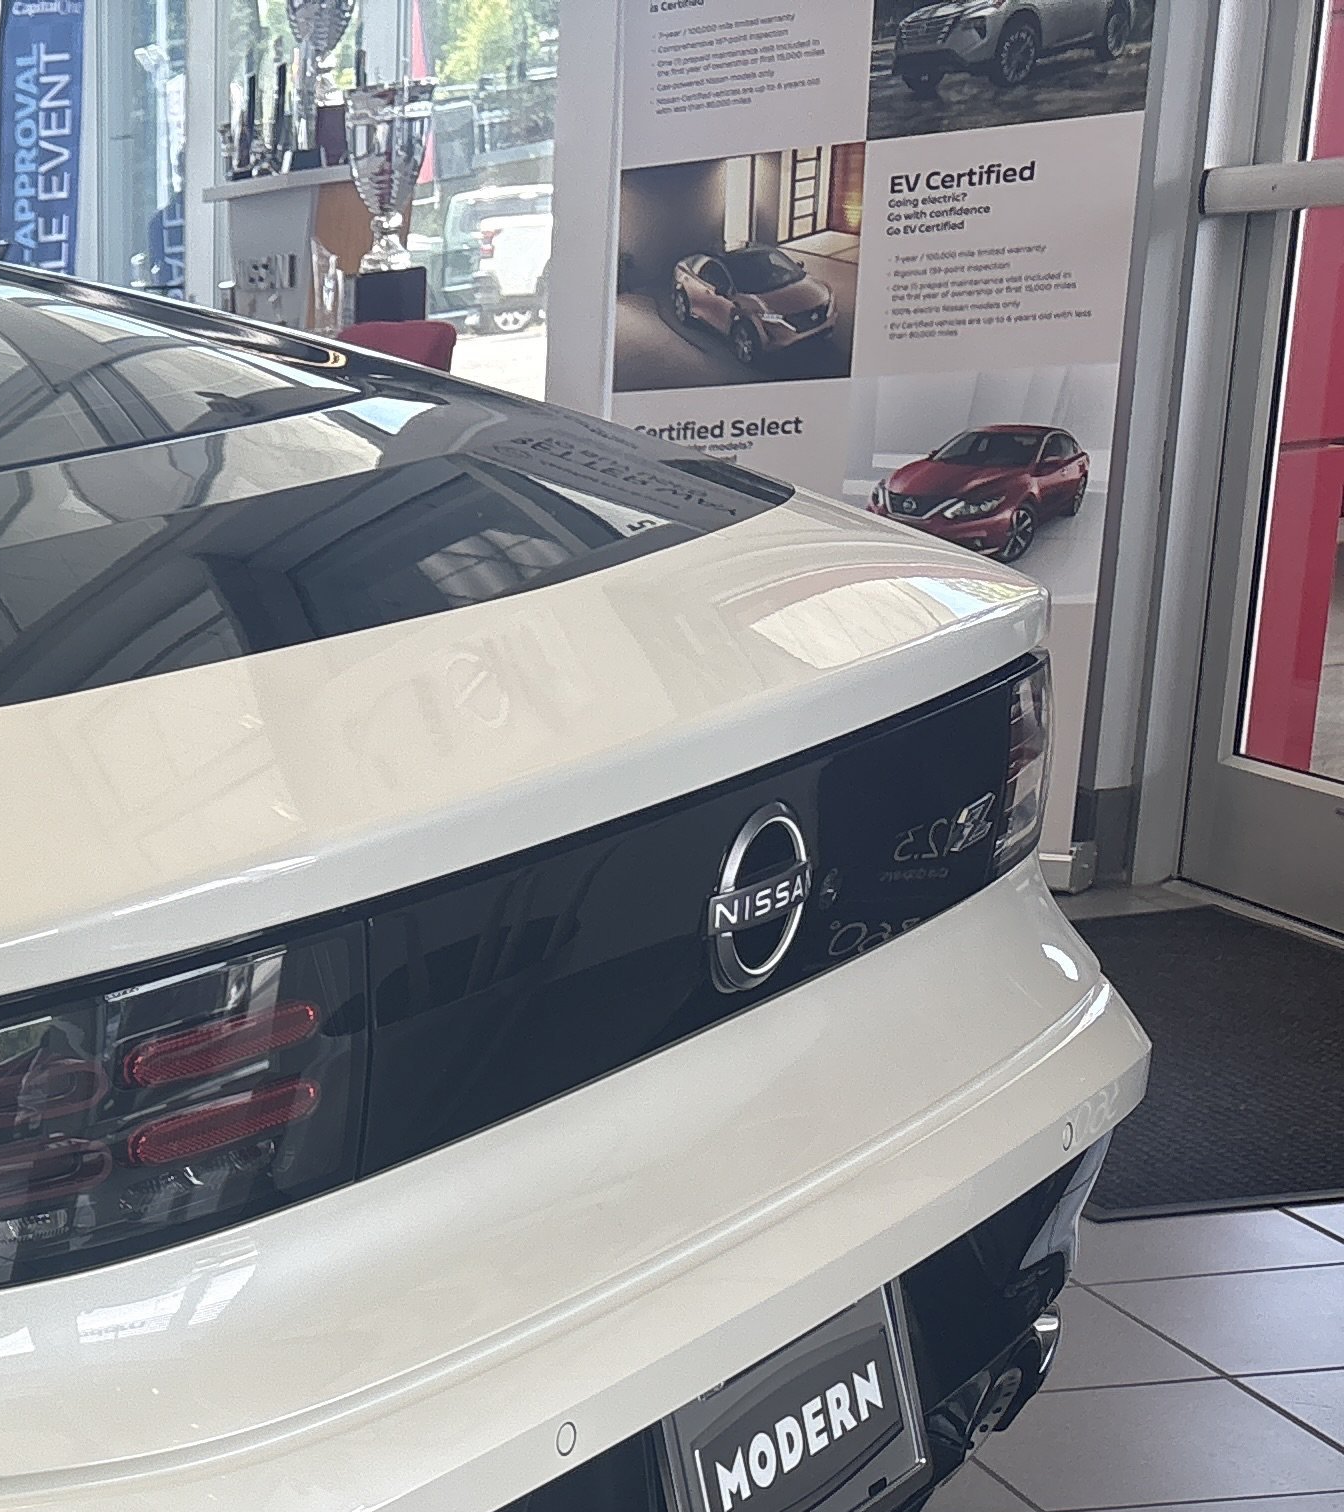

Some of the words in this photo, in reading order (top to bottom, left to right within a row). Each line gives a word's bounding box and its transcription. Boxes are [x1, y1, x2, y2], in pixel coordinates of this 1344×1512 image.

[37, 42, 72, 201] EVENT
[14, 43, 39, 263] -APPROVAL
[890, 173, 921, 194] EV
[926, 161, 1036, 190] Certified
[888, 198, 919, 208] Going
[921, 193, 967, 205] electric?
[887, 212, 902, 222] Go
[904, 209, 926, 220] with
[929, 204, 991, 218] confidence
[887, 226, 901, 236] Go
[903, 224, 917, 234] EV
[918, 220, 964, 233] Certified
[38, 214, 70, 271] LE
[1007, 244, 1047, 255] warranty
[1024, 272, 1061, 282] included
[922, 291, 939, 300] year
[941, 289, 949, 297] of
[951, 288, 992, 298] ownership
[1006, 285, 1022, 293] first
[1002, 300, 1020, 309] only
[1014, 313, 1036, 323] years
[730, 416, 804, 438] Select
[708, 441, 754, 452] models?
[714, 868, 812, 929] NISSAN
